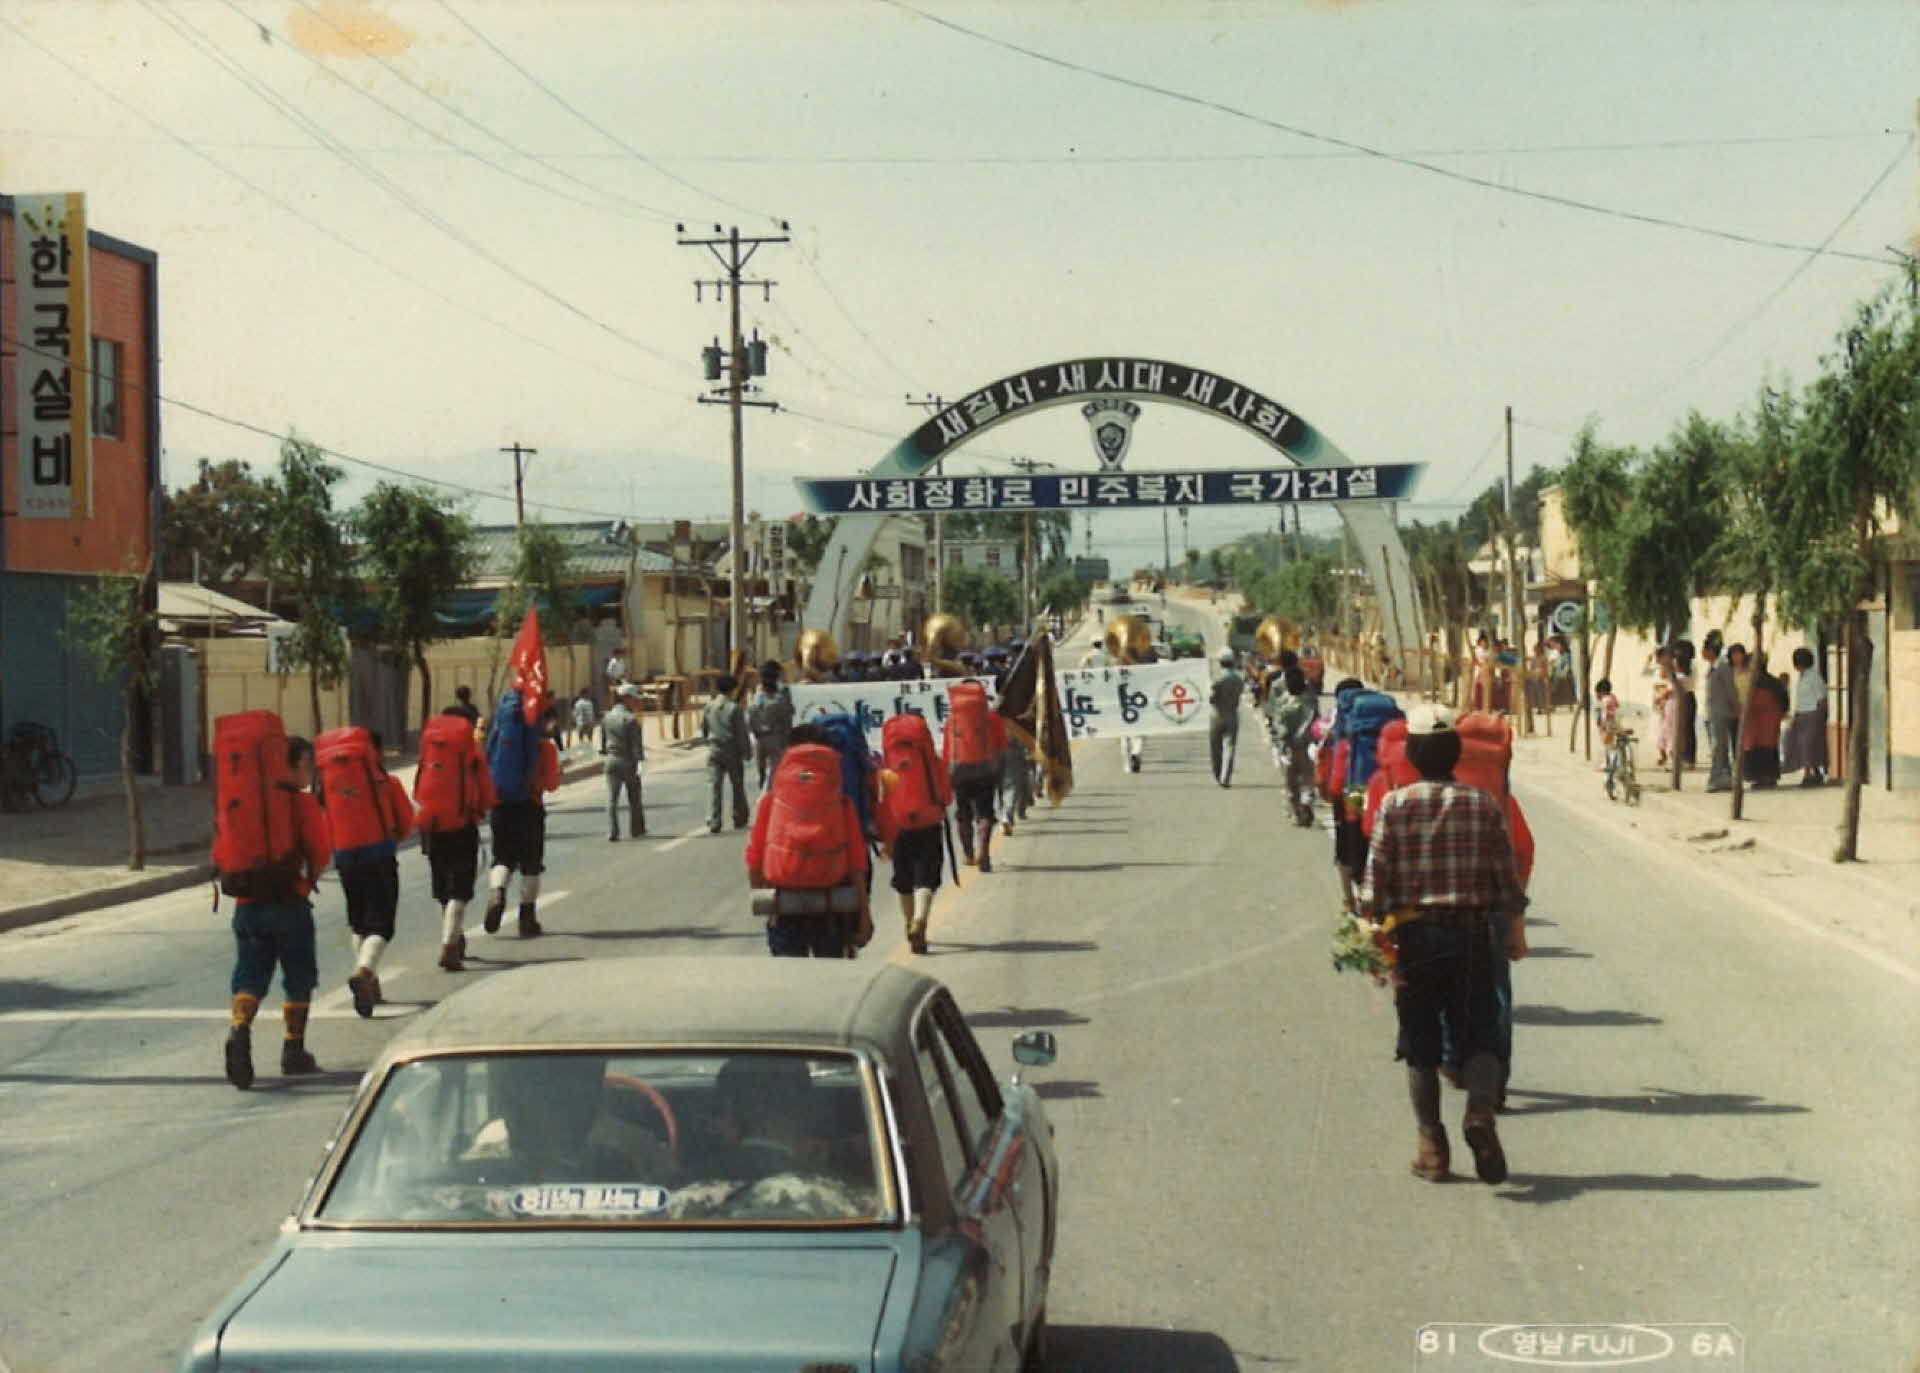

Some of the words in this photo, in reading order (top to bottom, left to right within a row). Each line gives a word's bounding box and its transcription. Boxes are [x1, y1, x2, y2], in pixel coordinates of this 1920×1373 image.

[31, 235, 72, 487] 한국설비
[847, 477, 1036, 510] 사회정화로
[1059, 473, 1204, 505] 민주복지
[1229, 467, 1378, 502] 국가건설
